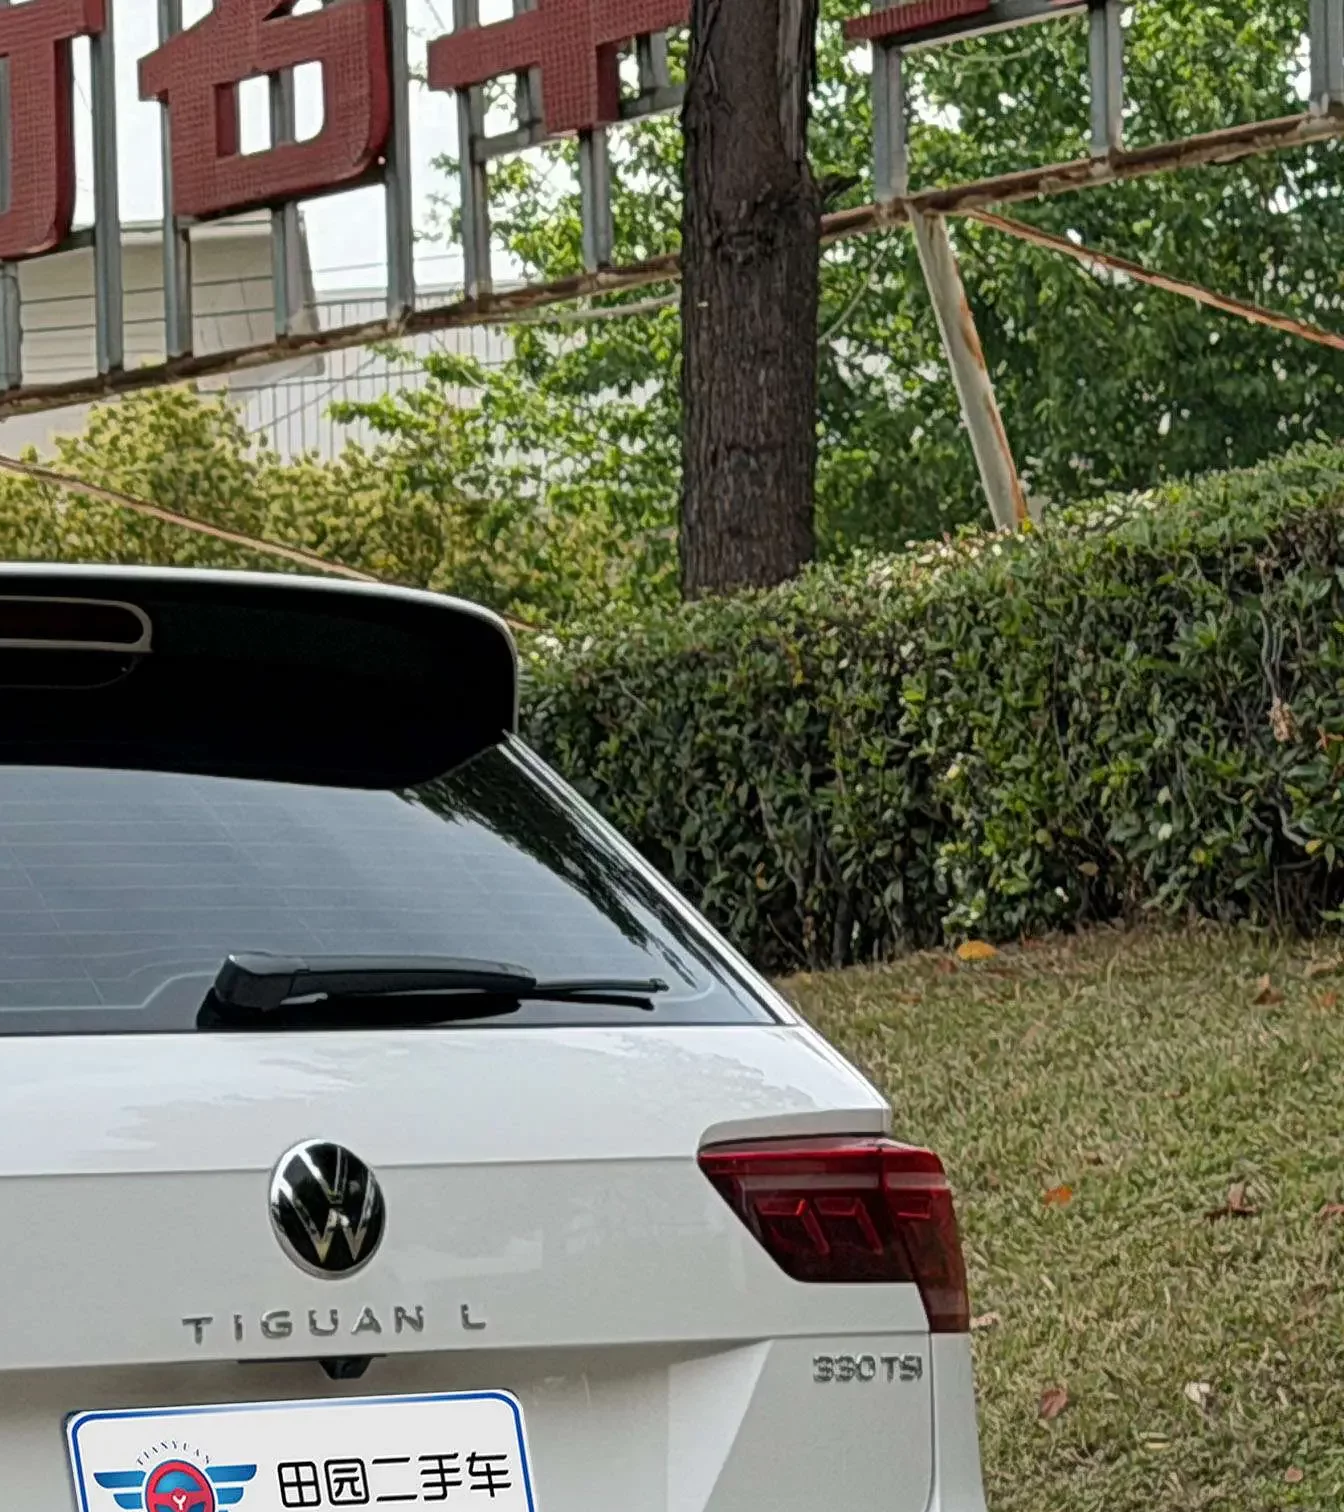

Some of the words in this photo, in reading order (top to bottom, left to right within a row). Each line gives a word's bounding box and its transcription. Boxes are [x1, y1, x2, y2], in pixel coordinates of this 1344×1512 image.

[181, 1305, 425, 1345] TIGUAN
[460, 1303, 487, 1330] L
[277, 1452, 512, 1508] 田园二手车
